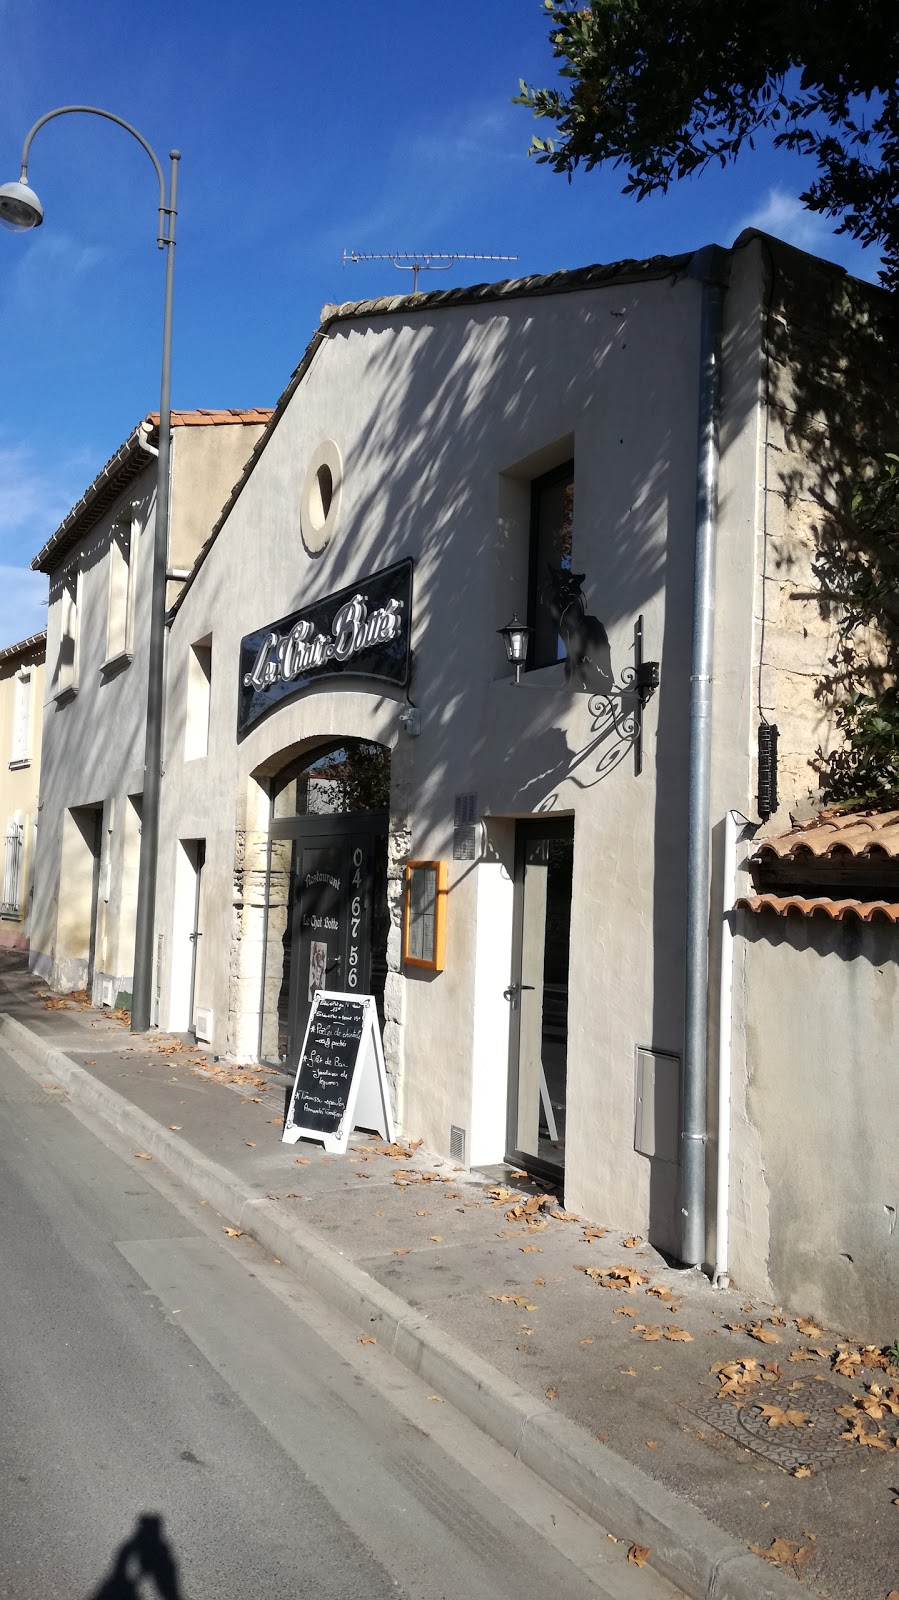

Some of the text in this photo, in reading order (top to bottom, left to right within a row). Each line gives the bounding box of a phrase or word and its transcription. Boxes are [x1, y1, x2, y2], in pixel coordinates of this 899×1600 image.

[243, 632, 278, 692] Le
[277, 619, 328, 682] Chat
[304, 870, 341, 890] Restaurant
[302, 913, 310, 926] Le
[310, 914, 322, 930] Chat
